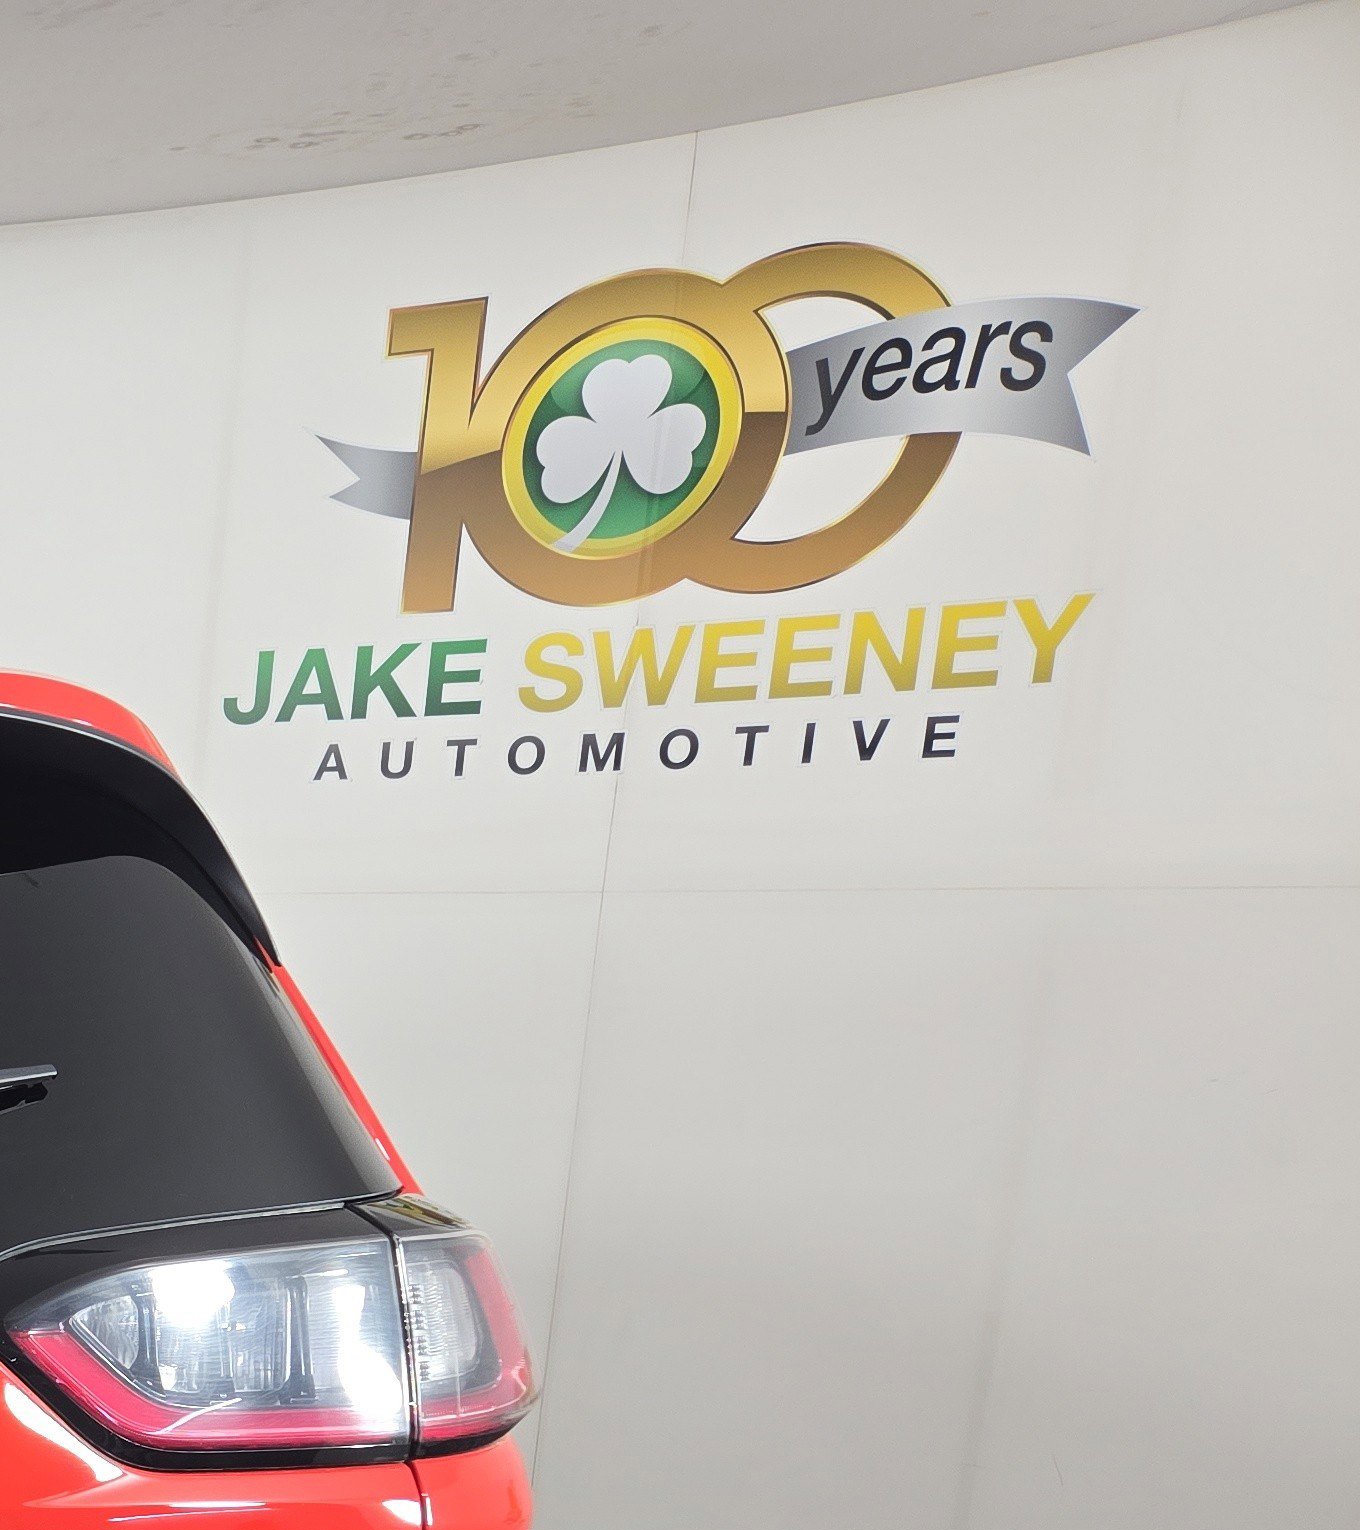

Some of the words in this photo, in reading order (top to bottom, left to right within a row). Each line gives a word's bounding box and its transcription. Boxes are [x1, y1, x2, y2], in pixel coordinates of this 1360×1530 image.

[385, 241, 964, 614] 100
[805, 319, 1054, 435] years
[222, 638, 488, 725] JAKE
[518, 593, 1096, 714] SWEENEY
[312, 714, 961, 782] AUTOMOTIVE
